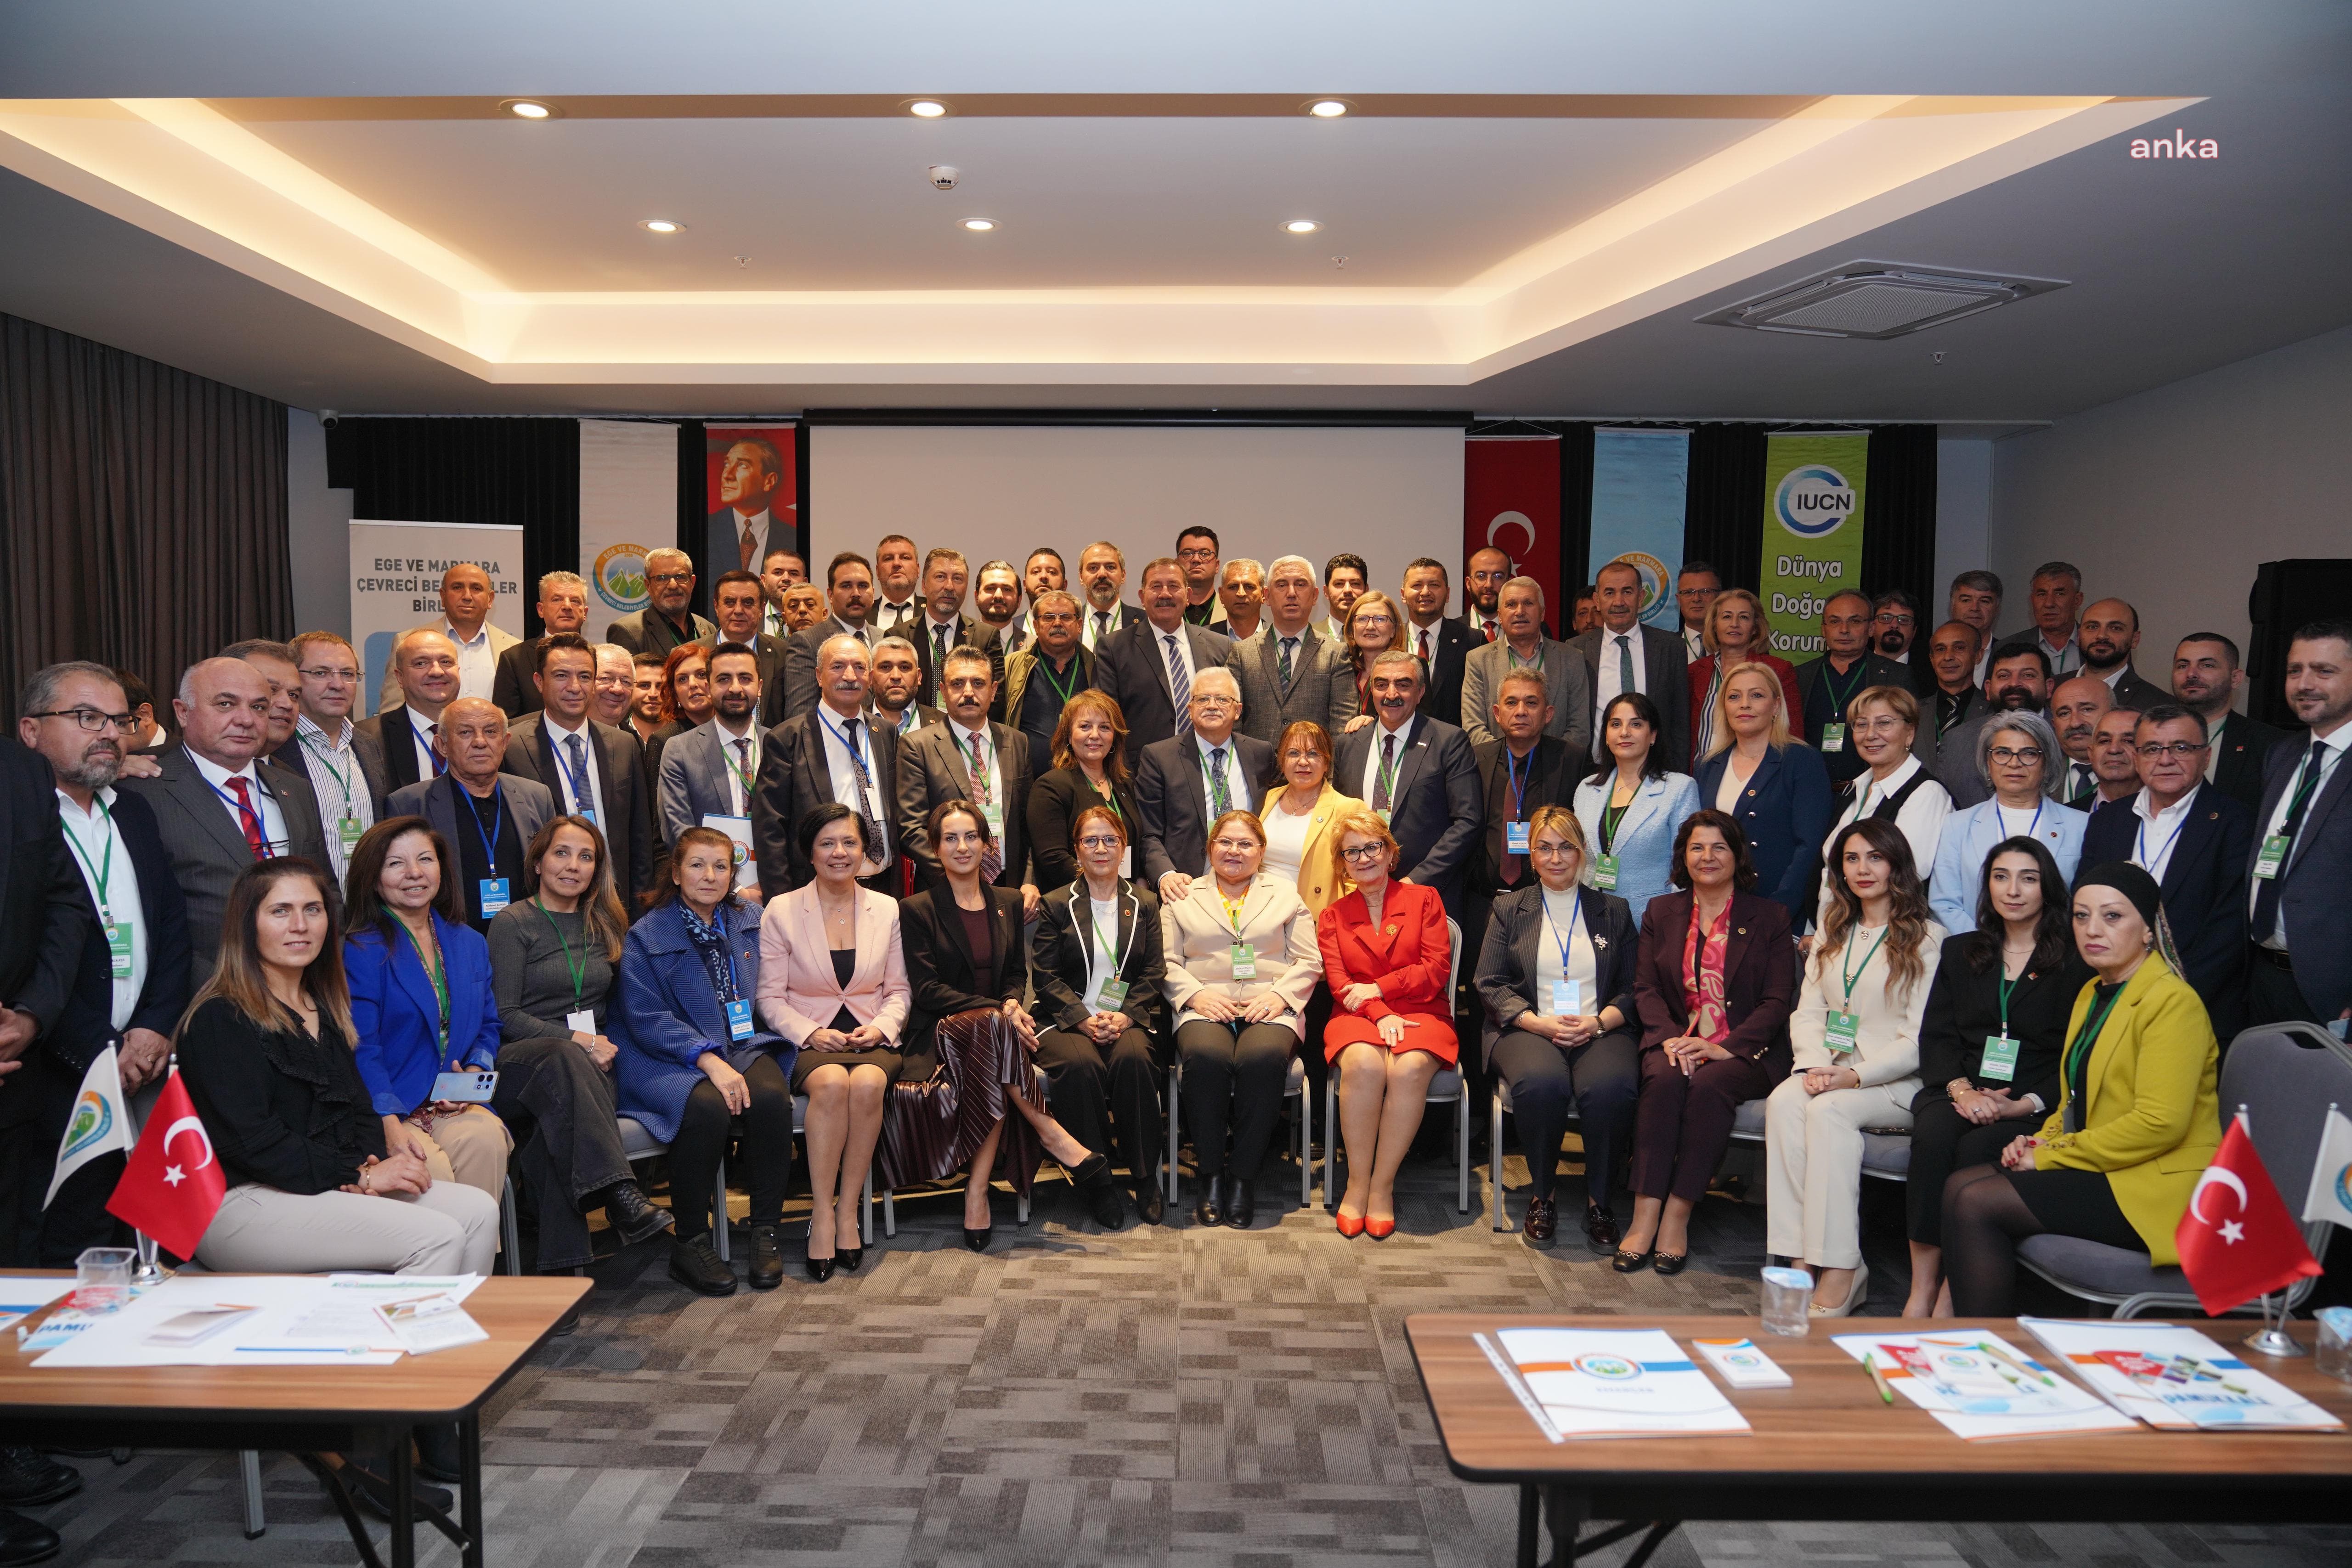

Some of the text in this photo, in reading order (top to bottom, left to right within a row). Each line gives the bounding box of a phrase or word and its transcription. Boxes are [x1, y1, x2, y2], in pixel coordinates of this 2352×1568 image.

[1797, 494, 1850, 510] IUCN
[603, 548, 616, 559] EGE
[374, 558, 402, 571] EGE
[406, 559, 424, 571] VE
[1636, 555, 1664, 577] MARMARA
[1776, 554, 1843, 583] Dünya
[356, 576, 417, 592] ÇEVRECİ
[413, 597, 446, 612] BİRL
[1769, 629, 1830, 653] Korum
